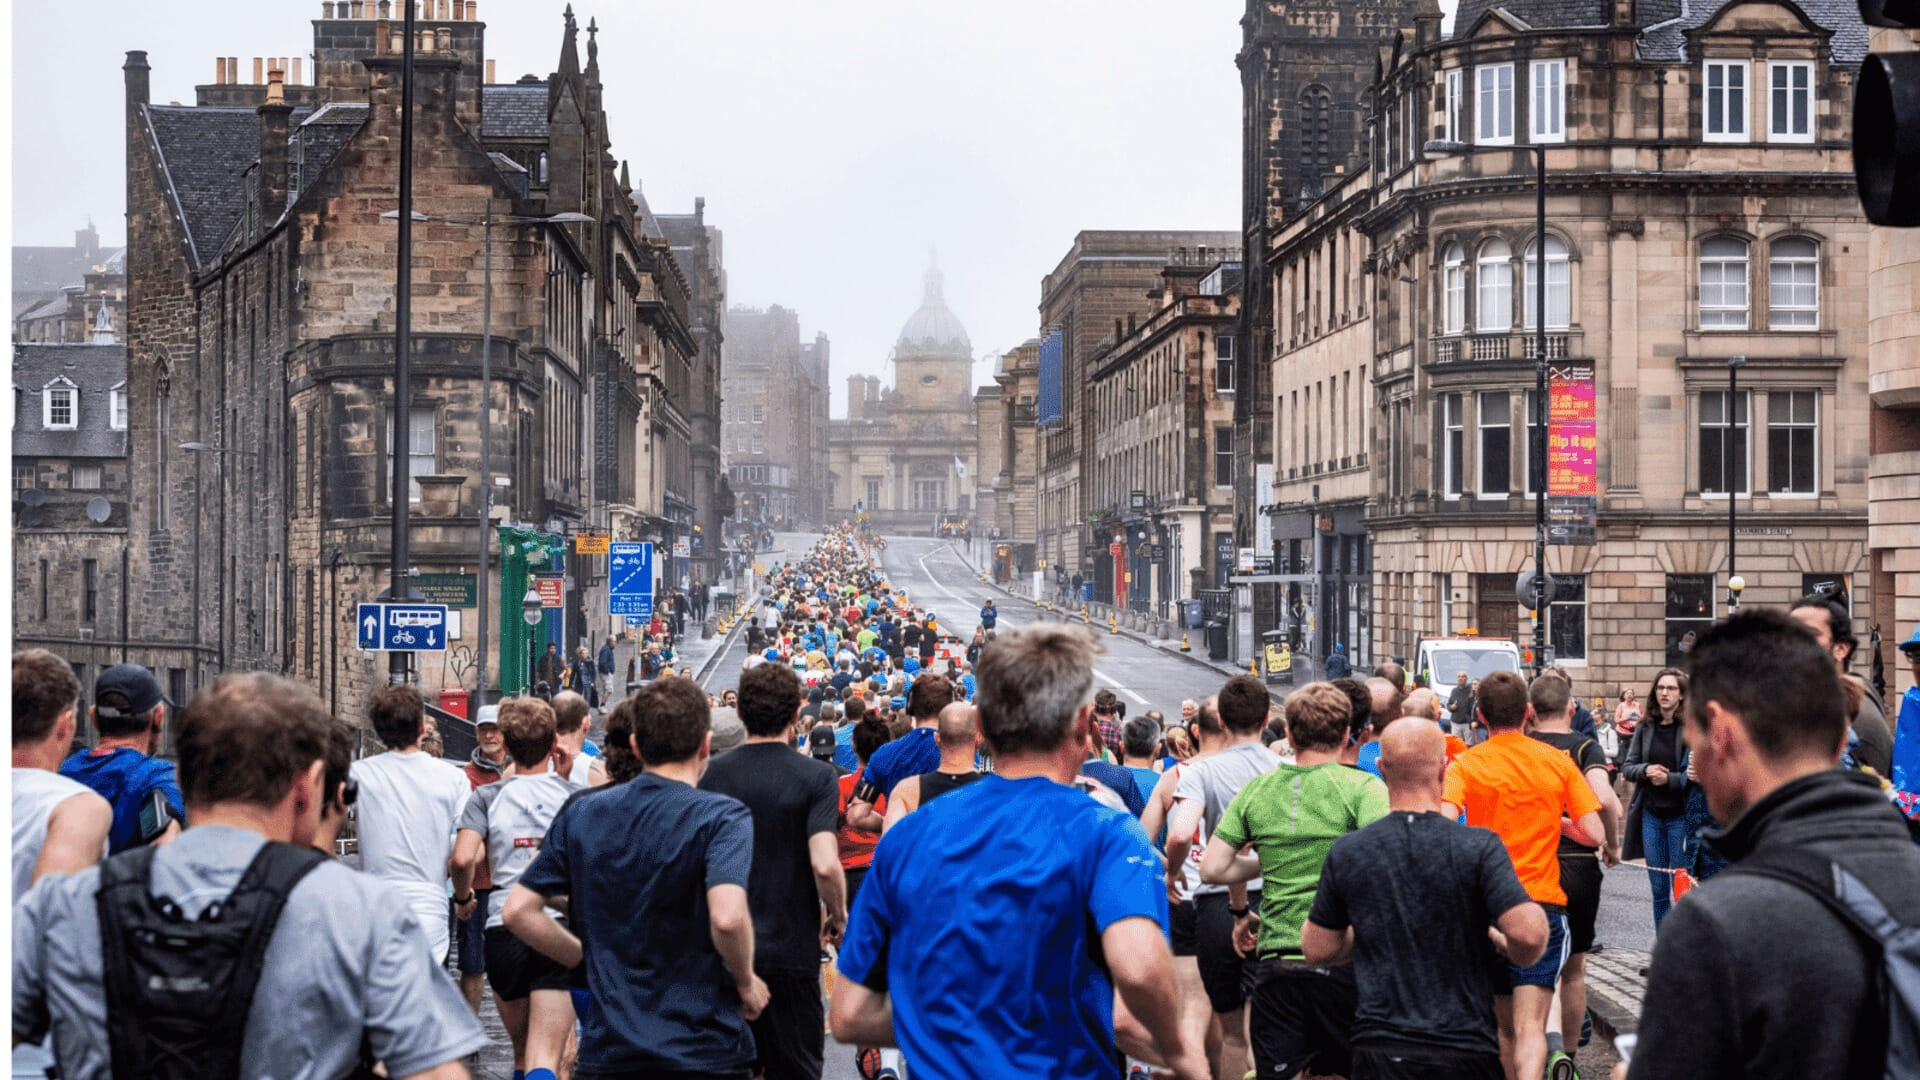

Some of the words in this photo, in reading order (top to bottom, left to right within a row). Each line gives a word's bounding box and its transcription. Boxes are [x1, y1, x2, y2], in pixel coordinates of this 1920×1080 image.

[1550, 434, 1568, 449] Rip
[1571, 434, 1579, 447] it
[1580, 437, 1596, 450] up
